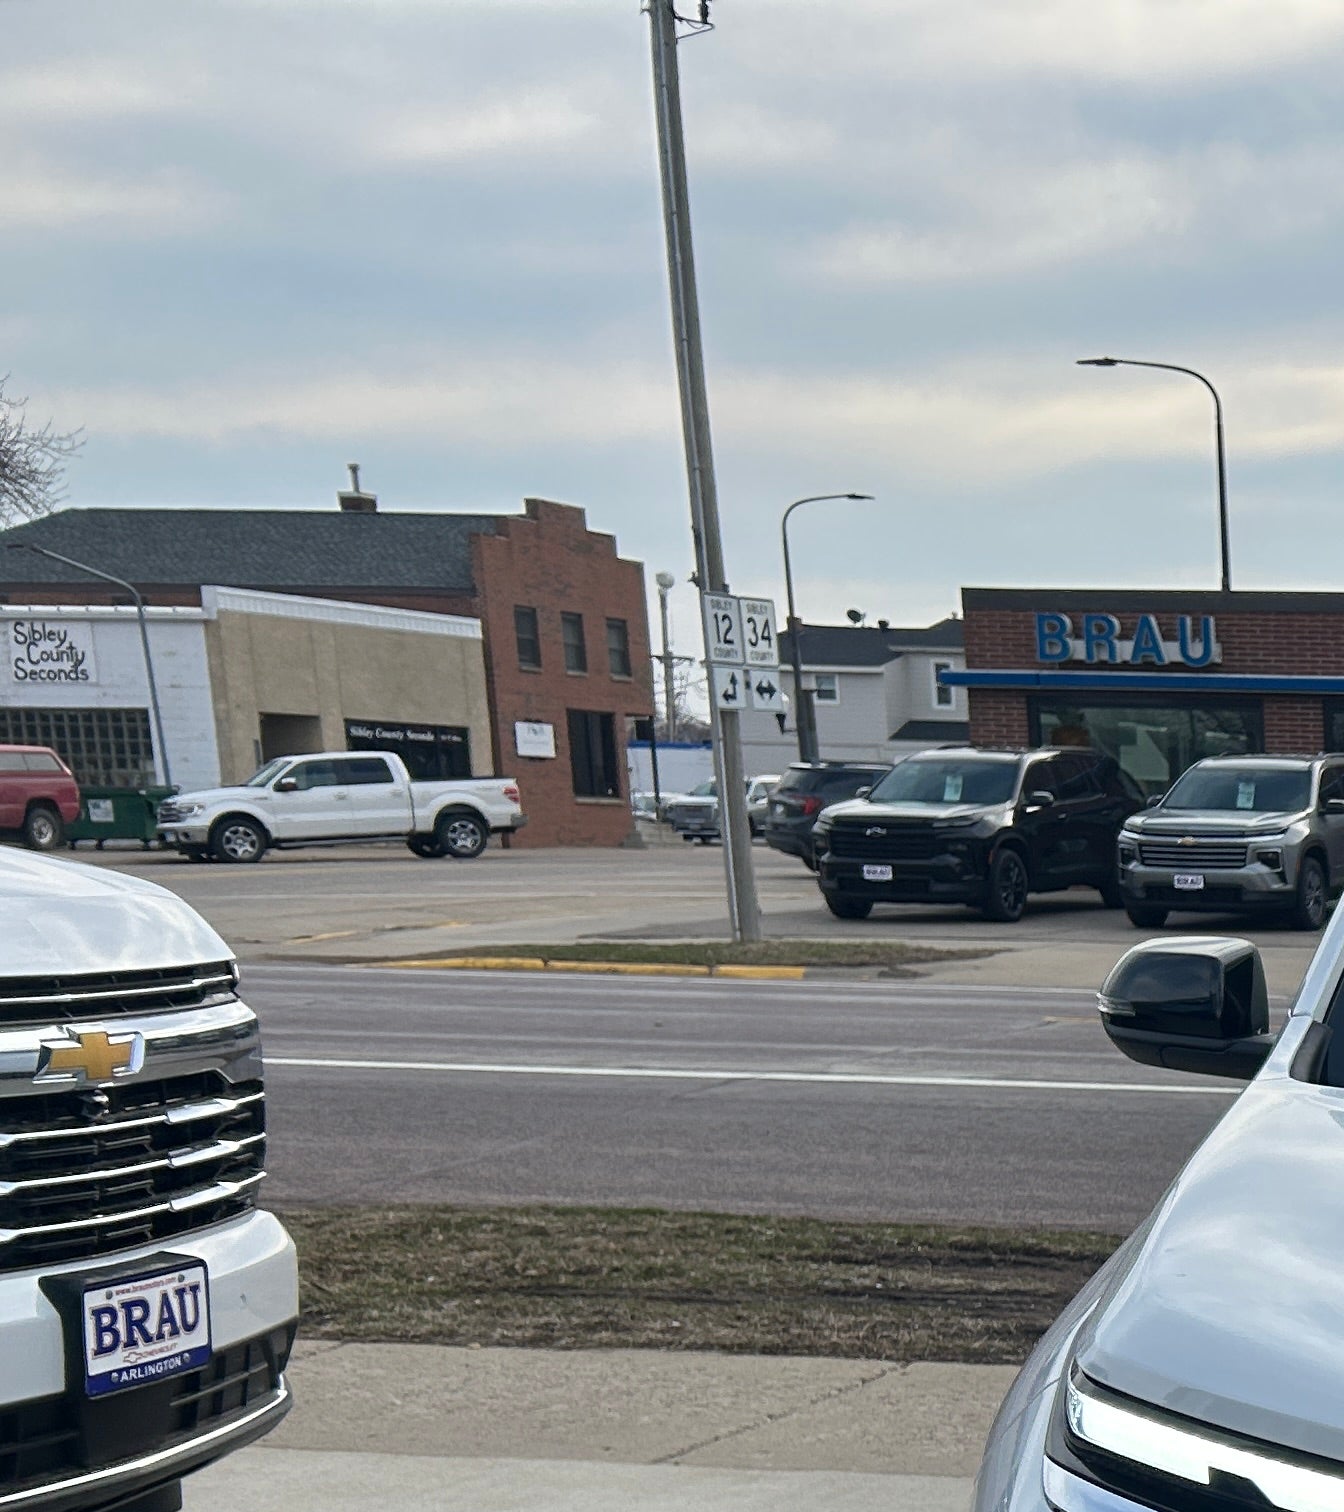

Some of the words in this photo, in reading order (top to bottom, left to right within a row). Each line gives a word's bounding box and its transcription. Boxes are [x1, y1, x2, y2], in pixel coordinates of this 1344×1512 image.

[13, 620, 67, 648] Sibley
[714, 611, 735, 645] 12
[747, 616, 772, 649] 34
[1034, 612, 1216, 667] BRAU
[14, 657, 89, 681] Seconds
[26, 640, 85, 668] County
[89, 1280, 201, 1359] BRAU
[119, 1355, 182, 1382] ARLINGTON
